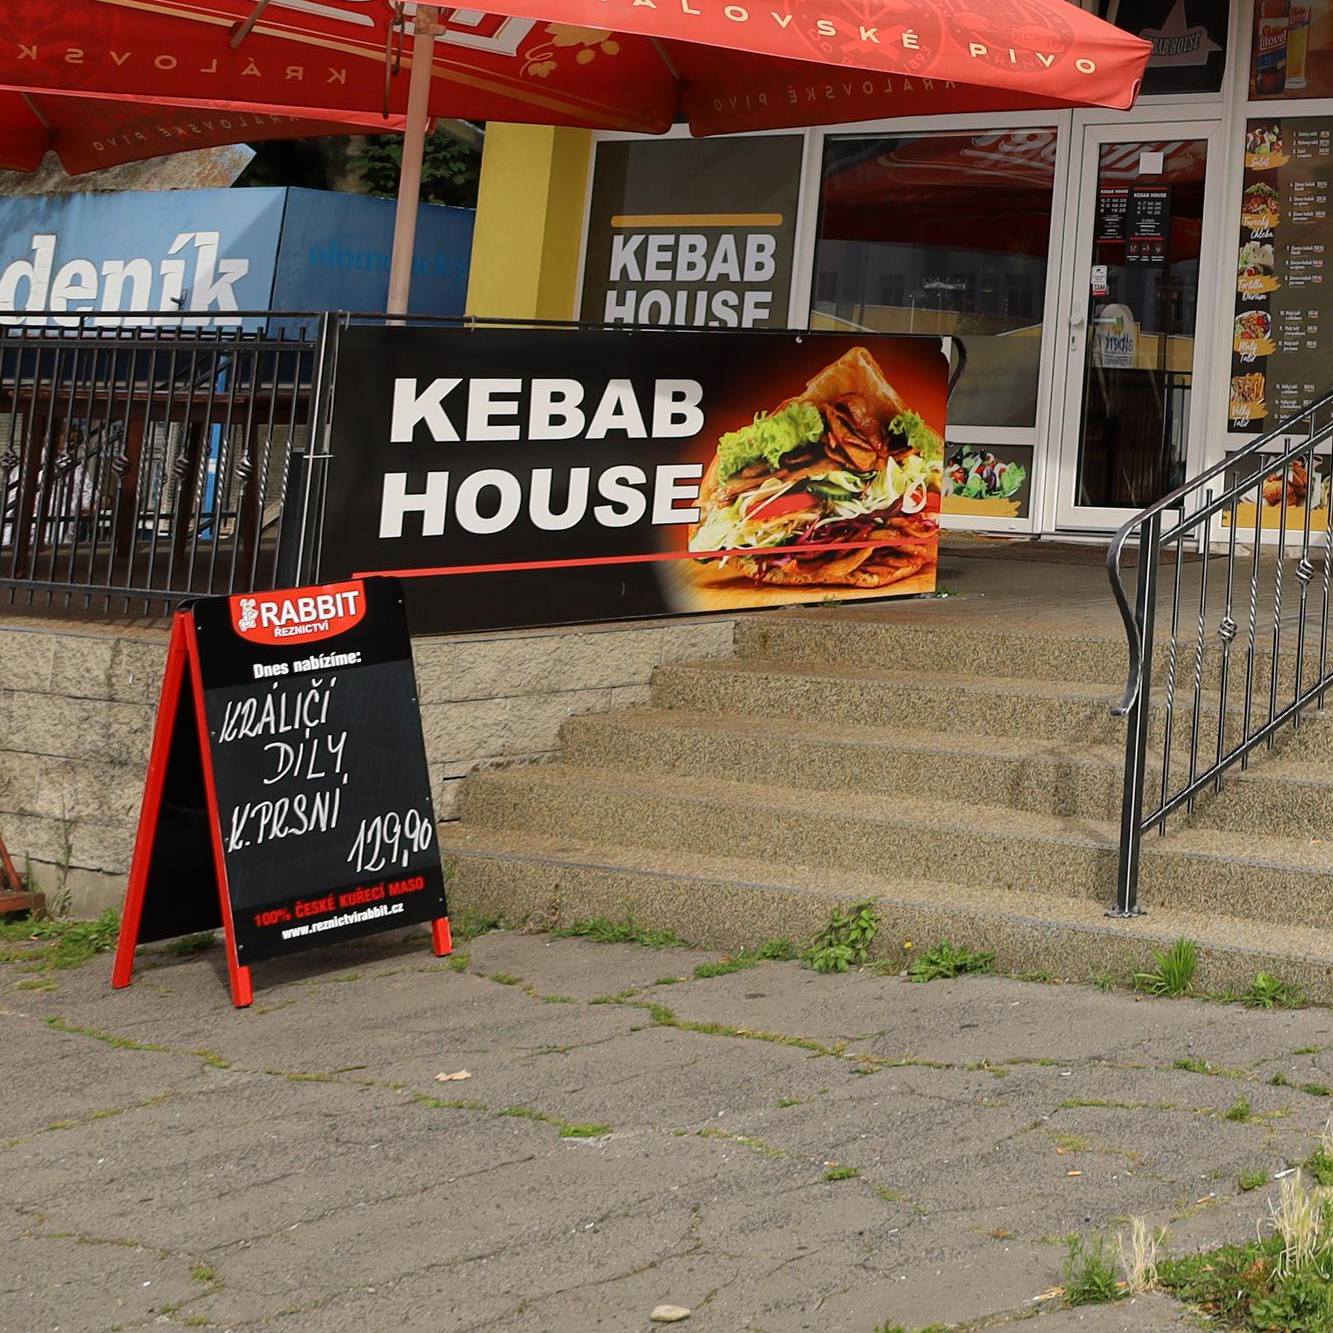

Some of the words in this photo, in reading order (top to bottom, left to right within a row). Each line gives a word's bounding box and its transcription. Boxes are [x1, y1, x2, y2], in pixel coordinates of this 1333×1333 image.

[970, 43, 1096, 75] PIVO
[0, 230, 250, 326] deník
[609, 234, 776, 282] KEBAB
[603, 289, 773, 329] HOUSE
[389, 377, 706, 443] KEBAB
[378, 464, 702, 539] HOUSE
[260, 590, 359, 628] RABBIT
[274, 619, 329, 637] ŘEZNICTVÍ
[253, 661, 289, 680] Dnes
[293, 650, 362, 674] nabízíme:
[218, 676, 337, 743] KRÁLIČÍ
[347, 809, 432, 873] 129,90
[254, 908, 292, 928] 100%
[294, 893, 336, 919] ČESKÉ
[339, 883, 385, 908] KUŘECÍ
[388, 876, 425, 897] MASO
[281, 902, 404, 940] www.reznictvirabbit.cz
